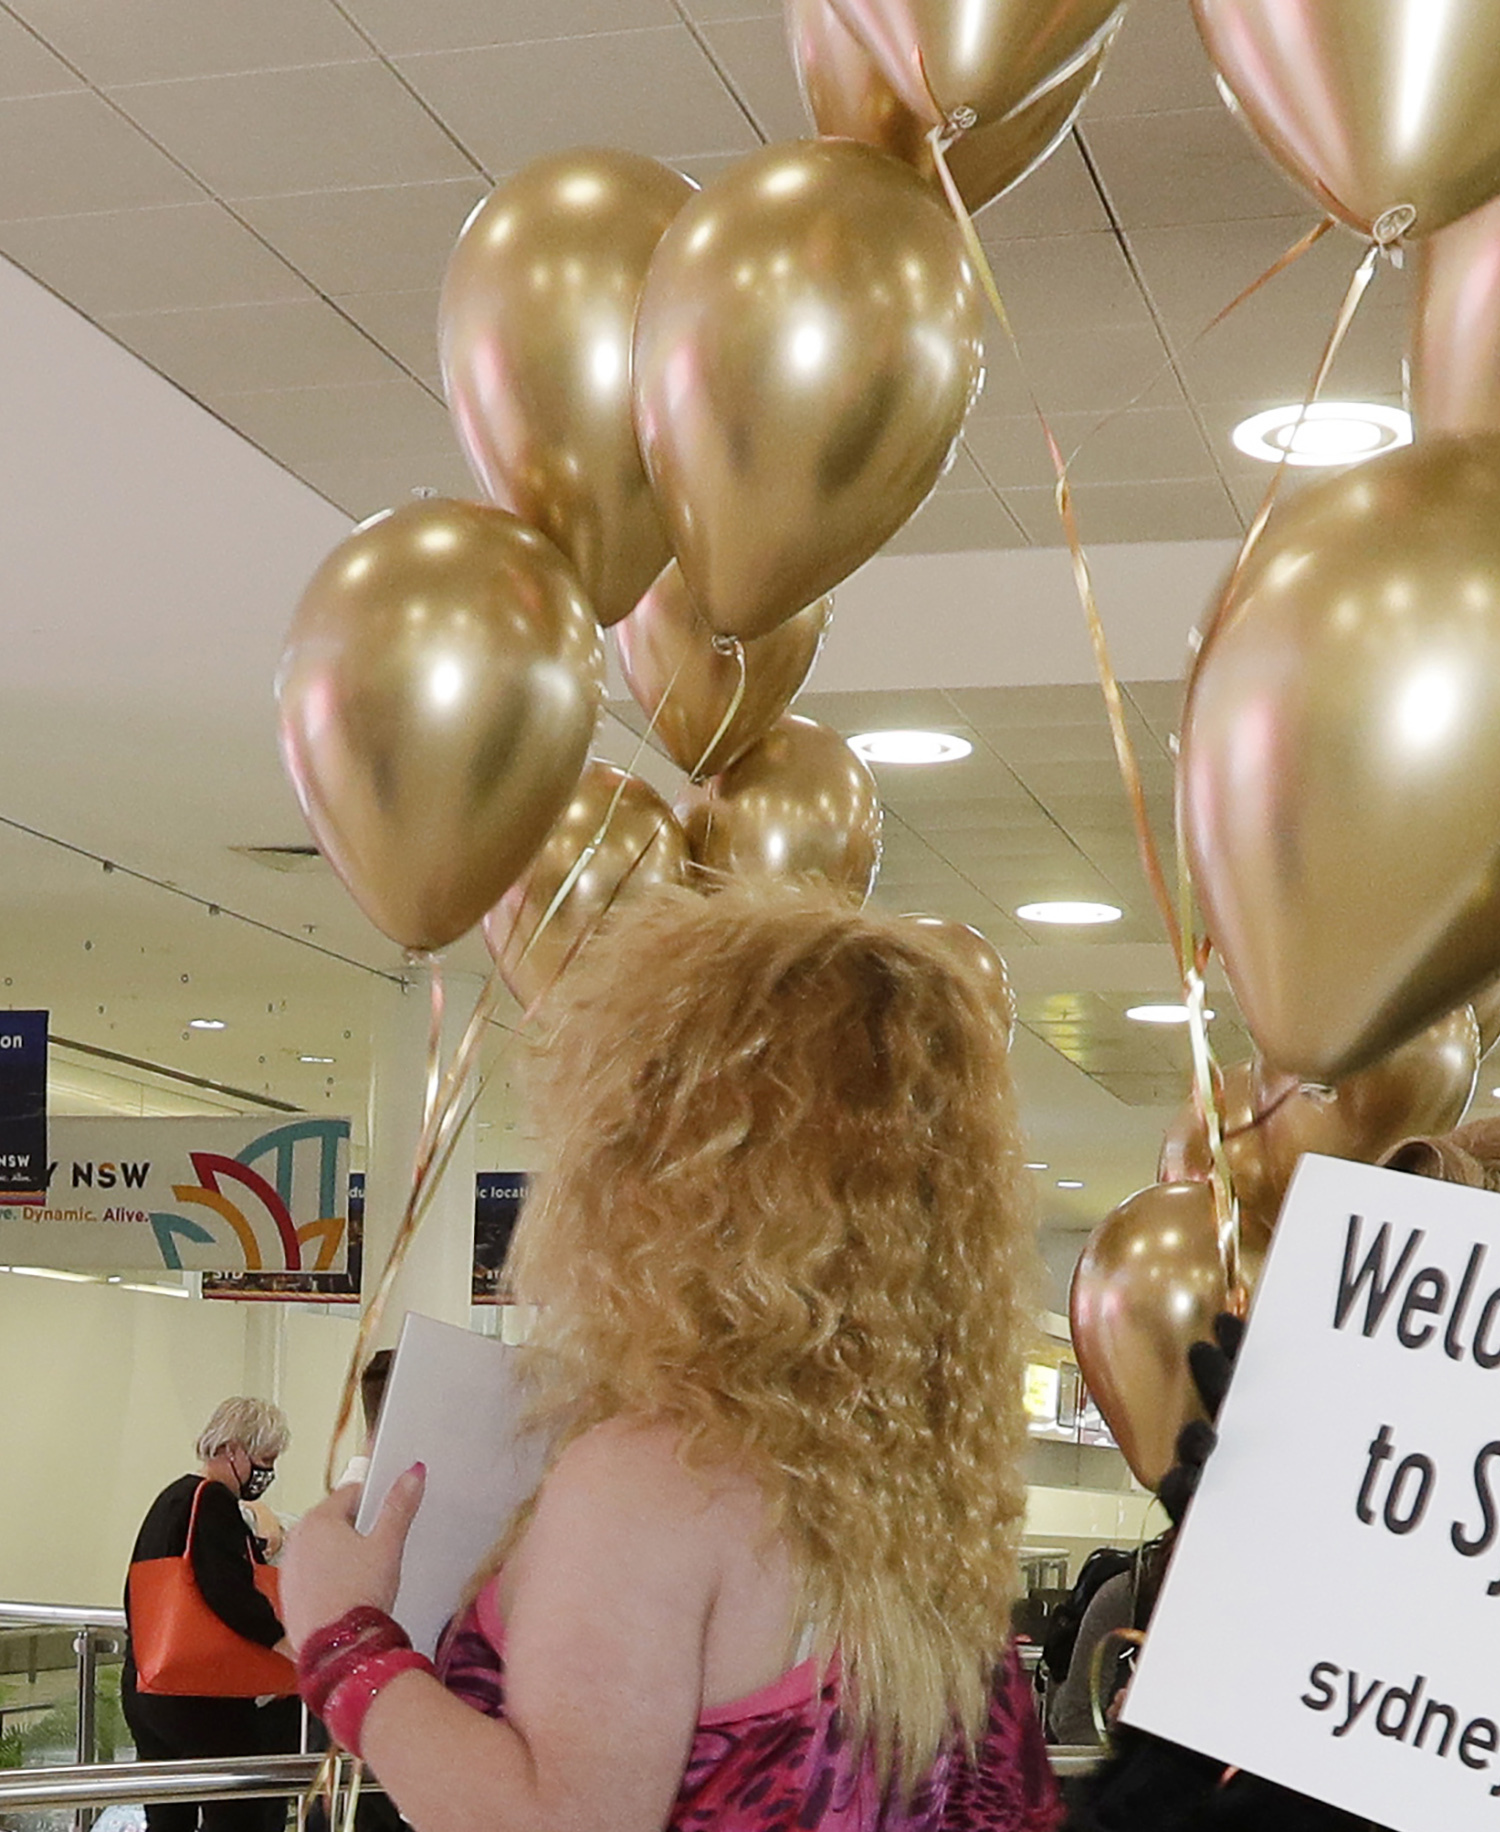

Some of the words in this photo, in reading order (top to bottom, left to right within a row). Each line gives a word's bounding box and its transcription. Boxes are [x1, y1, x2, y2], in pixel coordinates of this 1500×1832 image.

[72, 1161, 151, 1189] NSW
[22, 1205, 98, 1224] Dynamic.
[102, 1205, 150, 1224] Alive.
[1355, 1424, 1435, 1536] to
